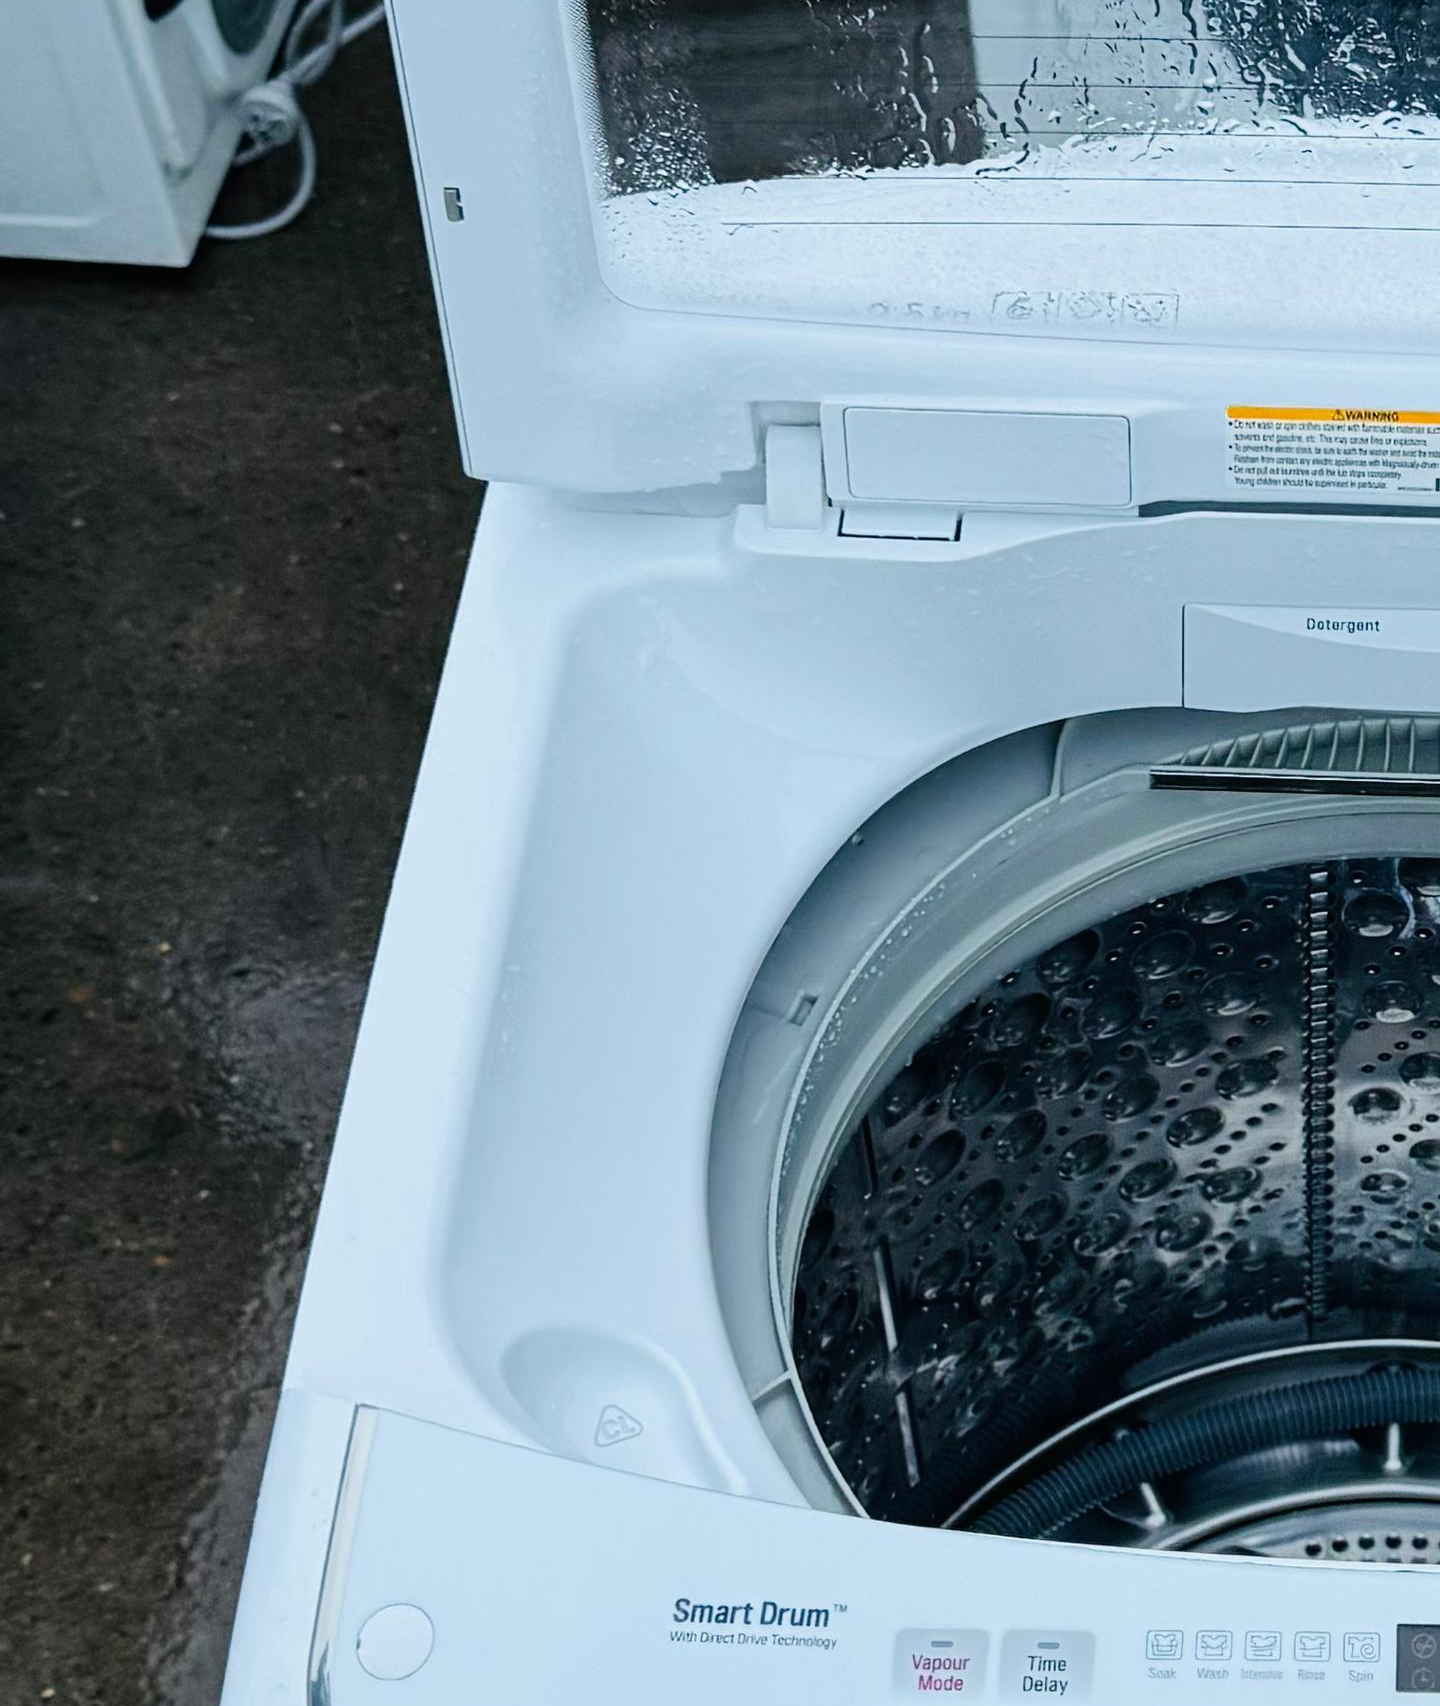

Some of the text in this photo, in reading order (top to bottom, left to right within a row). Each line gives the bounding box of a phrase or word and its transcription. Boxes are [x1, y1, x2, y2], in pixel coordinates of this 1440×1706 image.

[1344, 409, 1400, 423] WARNING
[1306, 617, 1380, 634] Detergent
[673, 1598, 753, 1625] Smart
[760, 1601, 830, 1627] Drum
[669, 1631, 697, 1643] With
[737, 1633, 768, 1645] Drive
[772, 1634, 837, 1650] Technology
[911, 1653, 971, 1674] Vapour
[1026, 1655, 1067, 1672] Time
[1148, 1667, 1176, 1679] Soak
[1197, 1668, 1229, 1680] Wash
[1349, 1670, 1373, 1683] Spin
[918, 1674, 964, 1692] Mode
[1022, 1675, 1069, 1696] Delay
